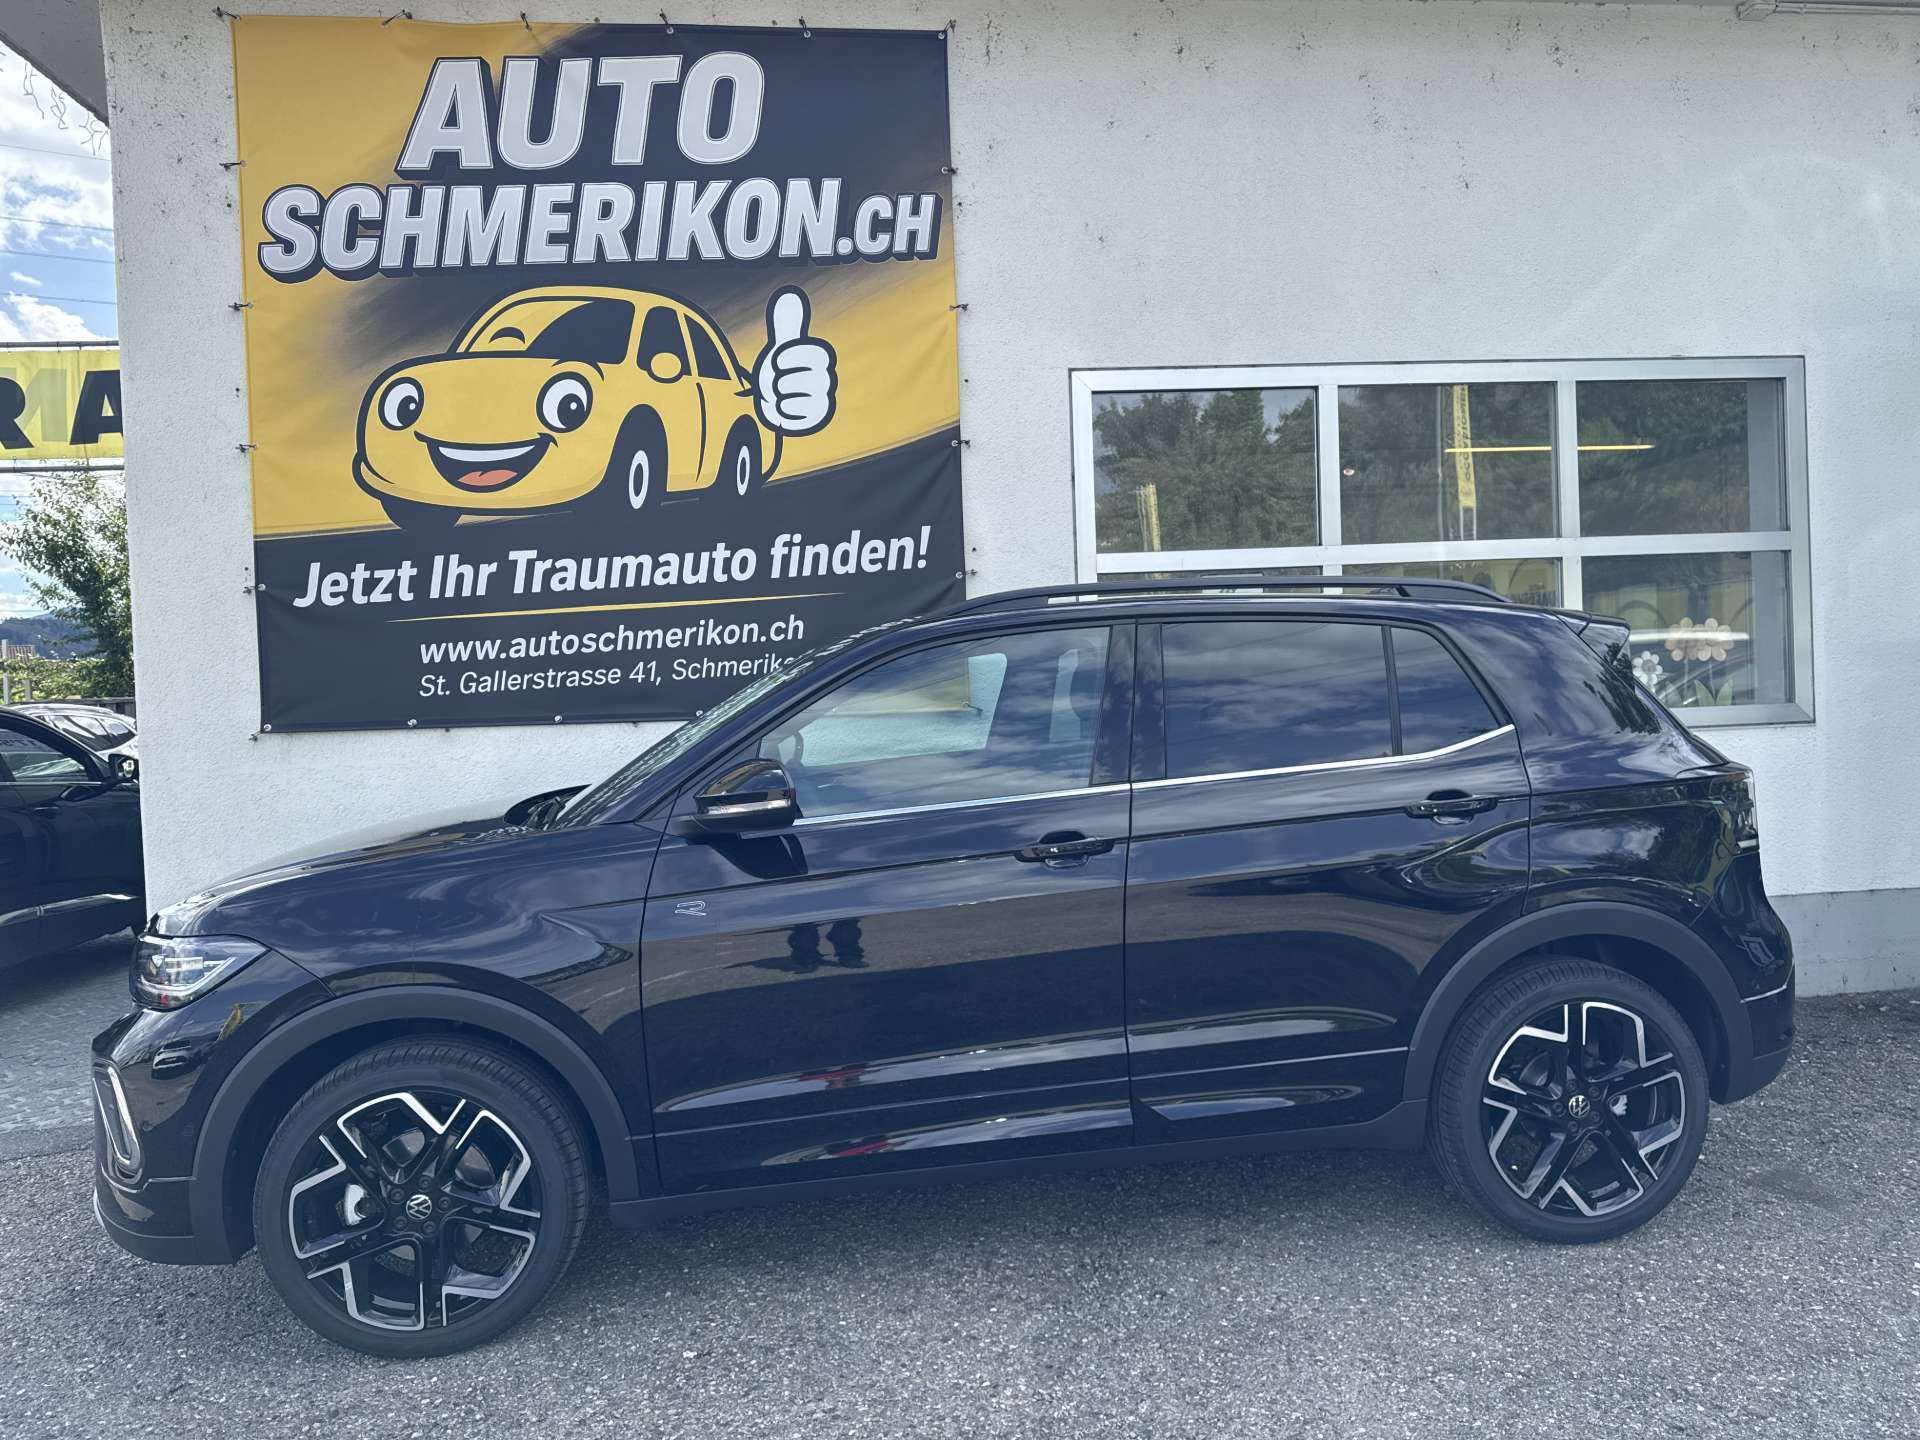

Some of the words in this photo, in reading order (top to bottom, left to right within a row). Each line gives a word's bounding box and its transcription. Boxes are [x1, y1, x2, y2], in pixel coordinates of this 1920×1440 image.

[396, 50, 765, 171] AUTO
[260, 177, 937, 274] SCHMERIKON.CH
[292, 560, 418, 608] Jetzt
[429, 553, 498, 599] Ihr
[508, 542, 758, 594] Traumauto
[769, 525, 933, 579] finden!
[418, 674, 452, 698] St.
[459, 667, 622, 695] Gallerstrasse
[628, 660, 662, 686] 41,
[419, 613, 805, 665] www.autoschmerikon.ch
